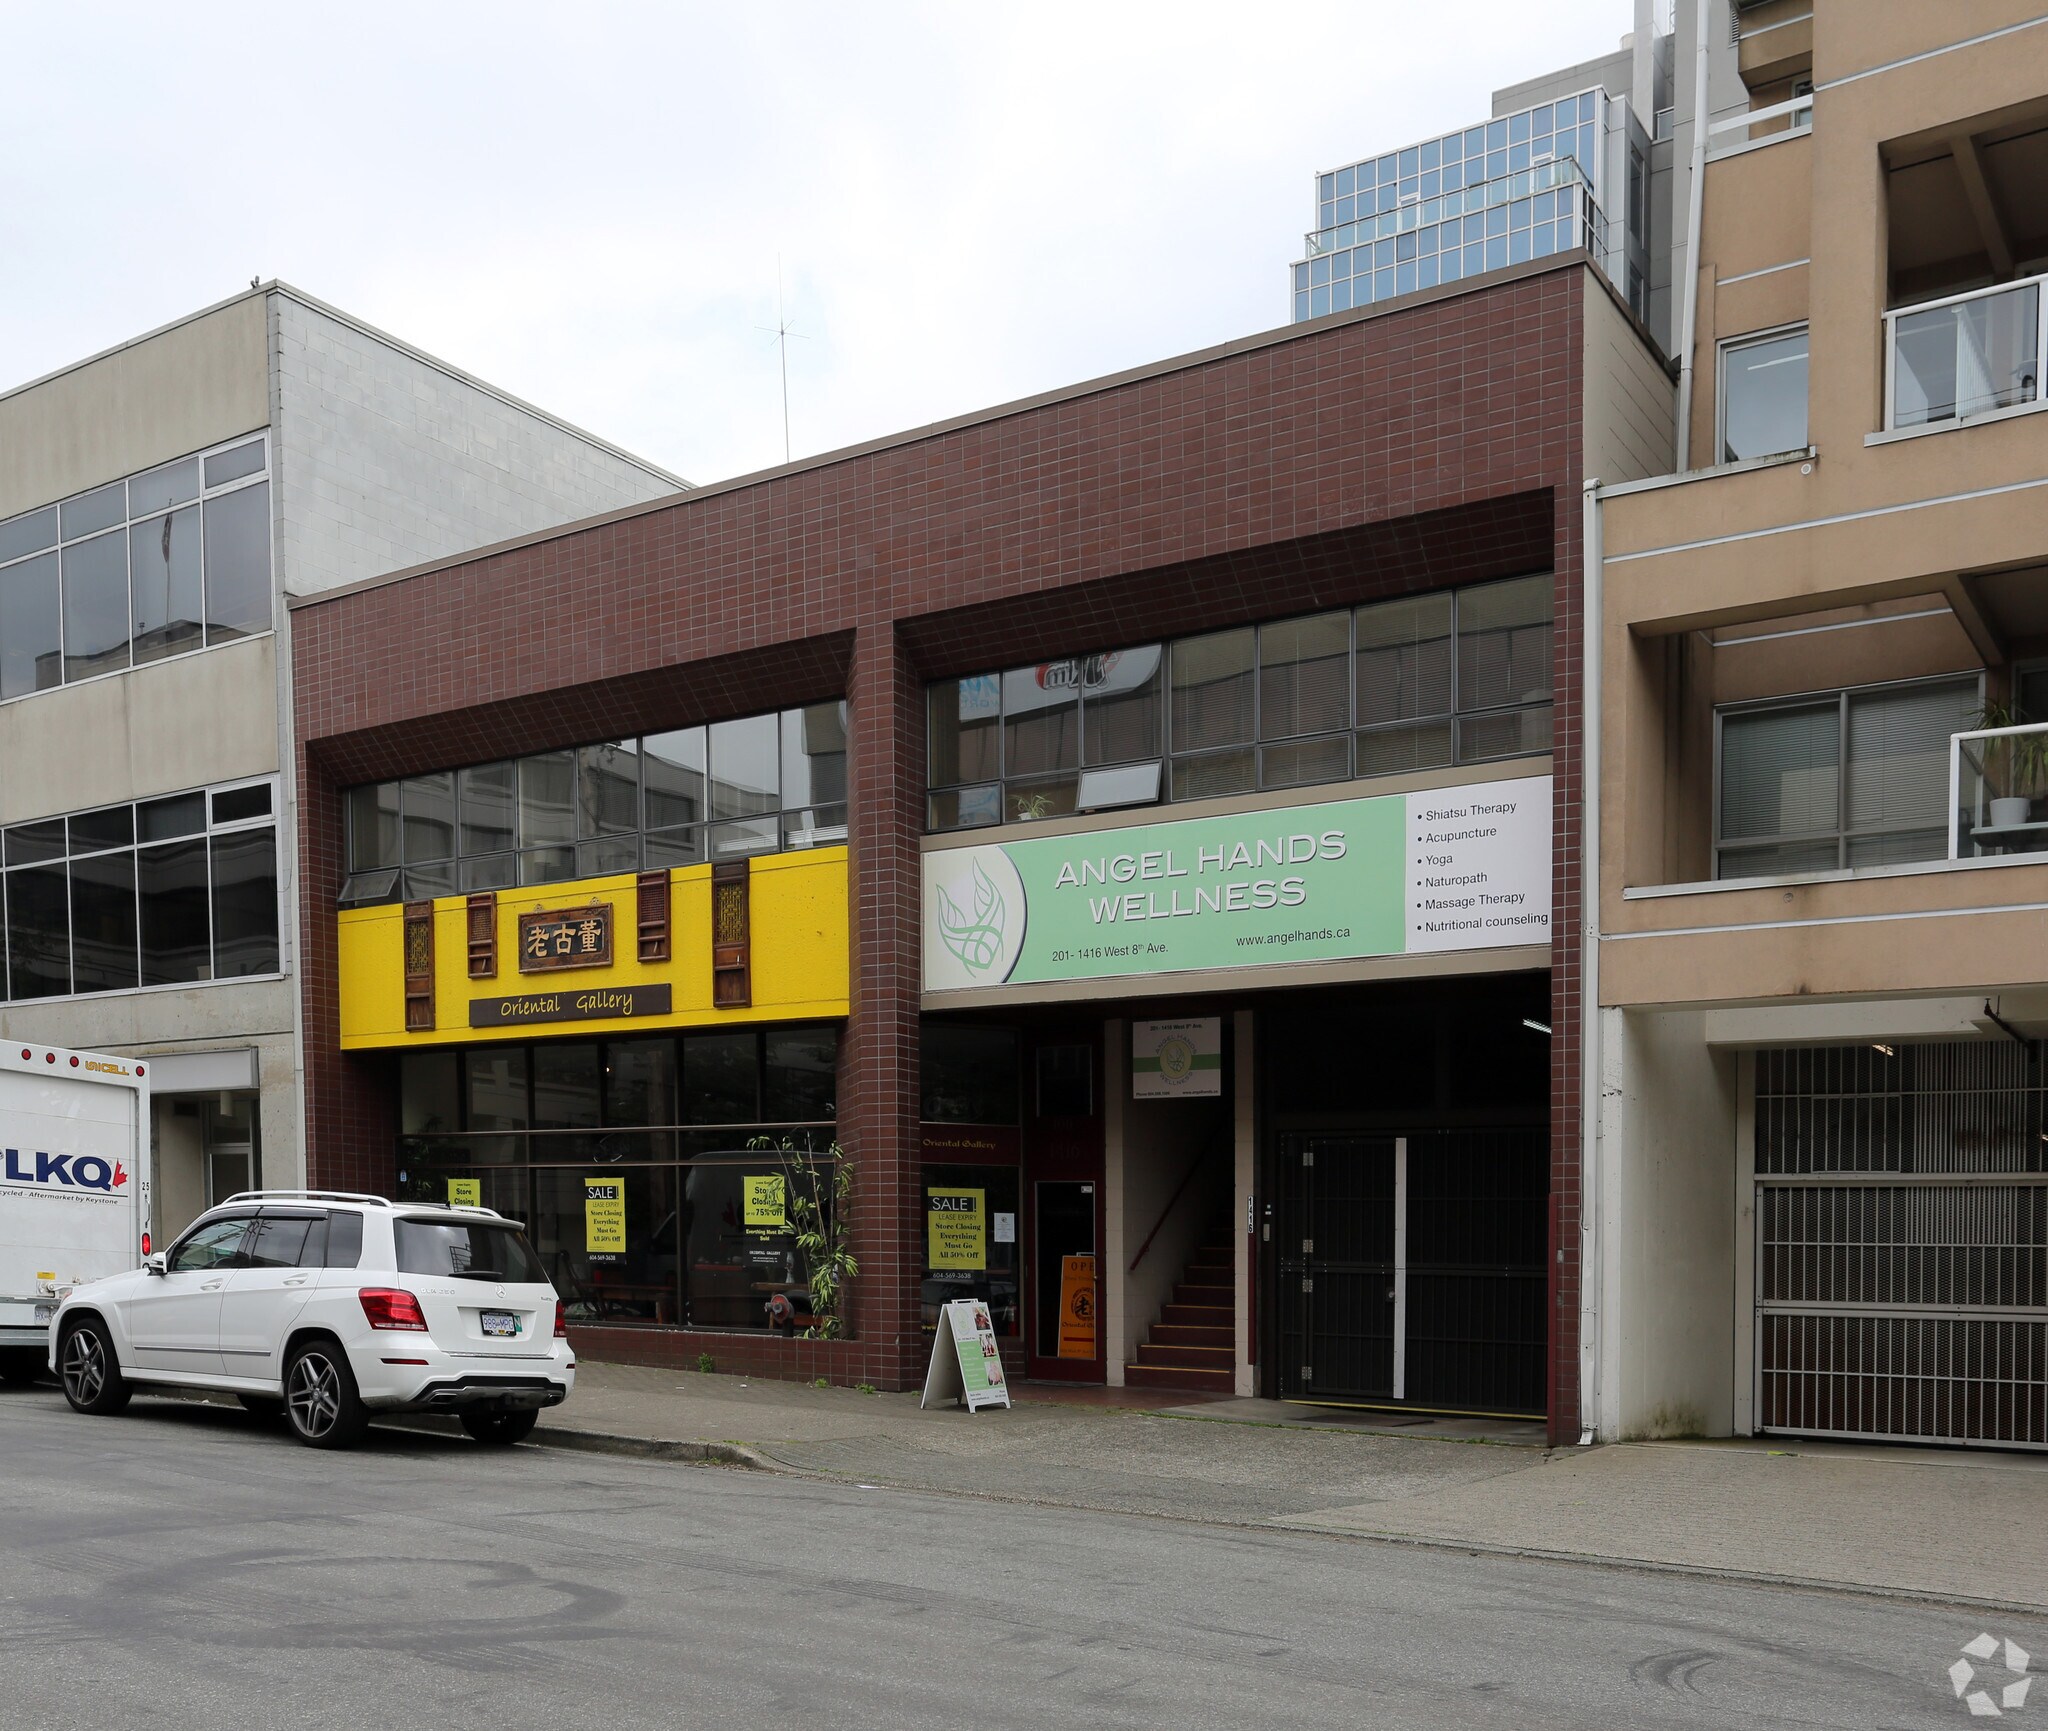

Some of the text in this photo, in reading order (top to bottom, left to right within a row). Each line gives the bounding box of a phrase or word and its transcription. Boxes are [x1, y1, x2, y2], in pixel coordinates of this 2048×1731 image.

[1426, 803, 1517, 821] Shiatsu Therapy
[1425, 827, 1497, 843] Acupuncture
[1055, 831, 1348, 889] ANGEL HANDS
[1426, 855, 1453, 867] Yoga
[1425, 872, 1488, 888] Naturopath
[1089, 877, 1307, 925] WELLNESS
[1425, 893, 1526, 910] Massage Therapy
[1425, 913, 1549, 932] Nutritional counseling
[527, 920, 601, 957] 老古董
[1236, 927, 1351, 947] www.angelhands.ca
[1078, 948, 1101, 959] 1416
[1104, 946, 1129, 958] West
[1132, 943, 1145, 956] 8th
[1147, 942, 1169, 954] Ave.
[501, 991, 633, 1016] Oriental Gallery
[1155, 1034, 1198, 1055] ANGEL HANDS
[1160, 1072, 1193, 1085] WELLNESS
[922, 1138, 996, 1150] Oriental Gallery
[6, 1149, 112, 1192] LKQ
[28, 1192, 74, 1202] Aftermarket
[85, 1196, 118, 1205] Keystone
[456, 1187, 472, 1195] Store
[588, 1187, 613, 1199] SALE
[454, 1197, 474, 1206] Closing
[932, 1197, 967, 1211] SALE
[955, 1223, 981, 1231] Closing
[940, 1232, 977, 1241] Everything
[966, 1251, 979, 1259] Off
[1071, 1262, 1094, 1271] OPE
